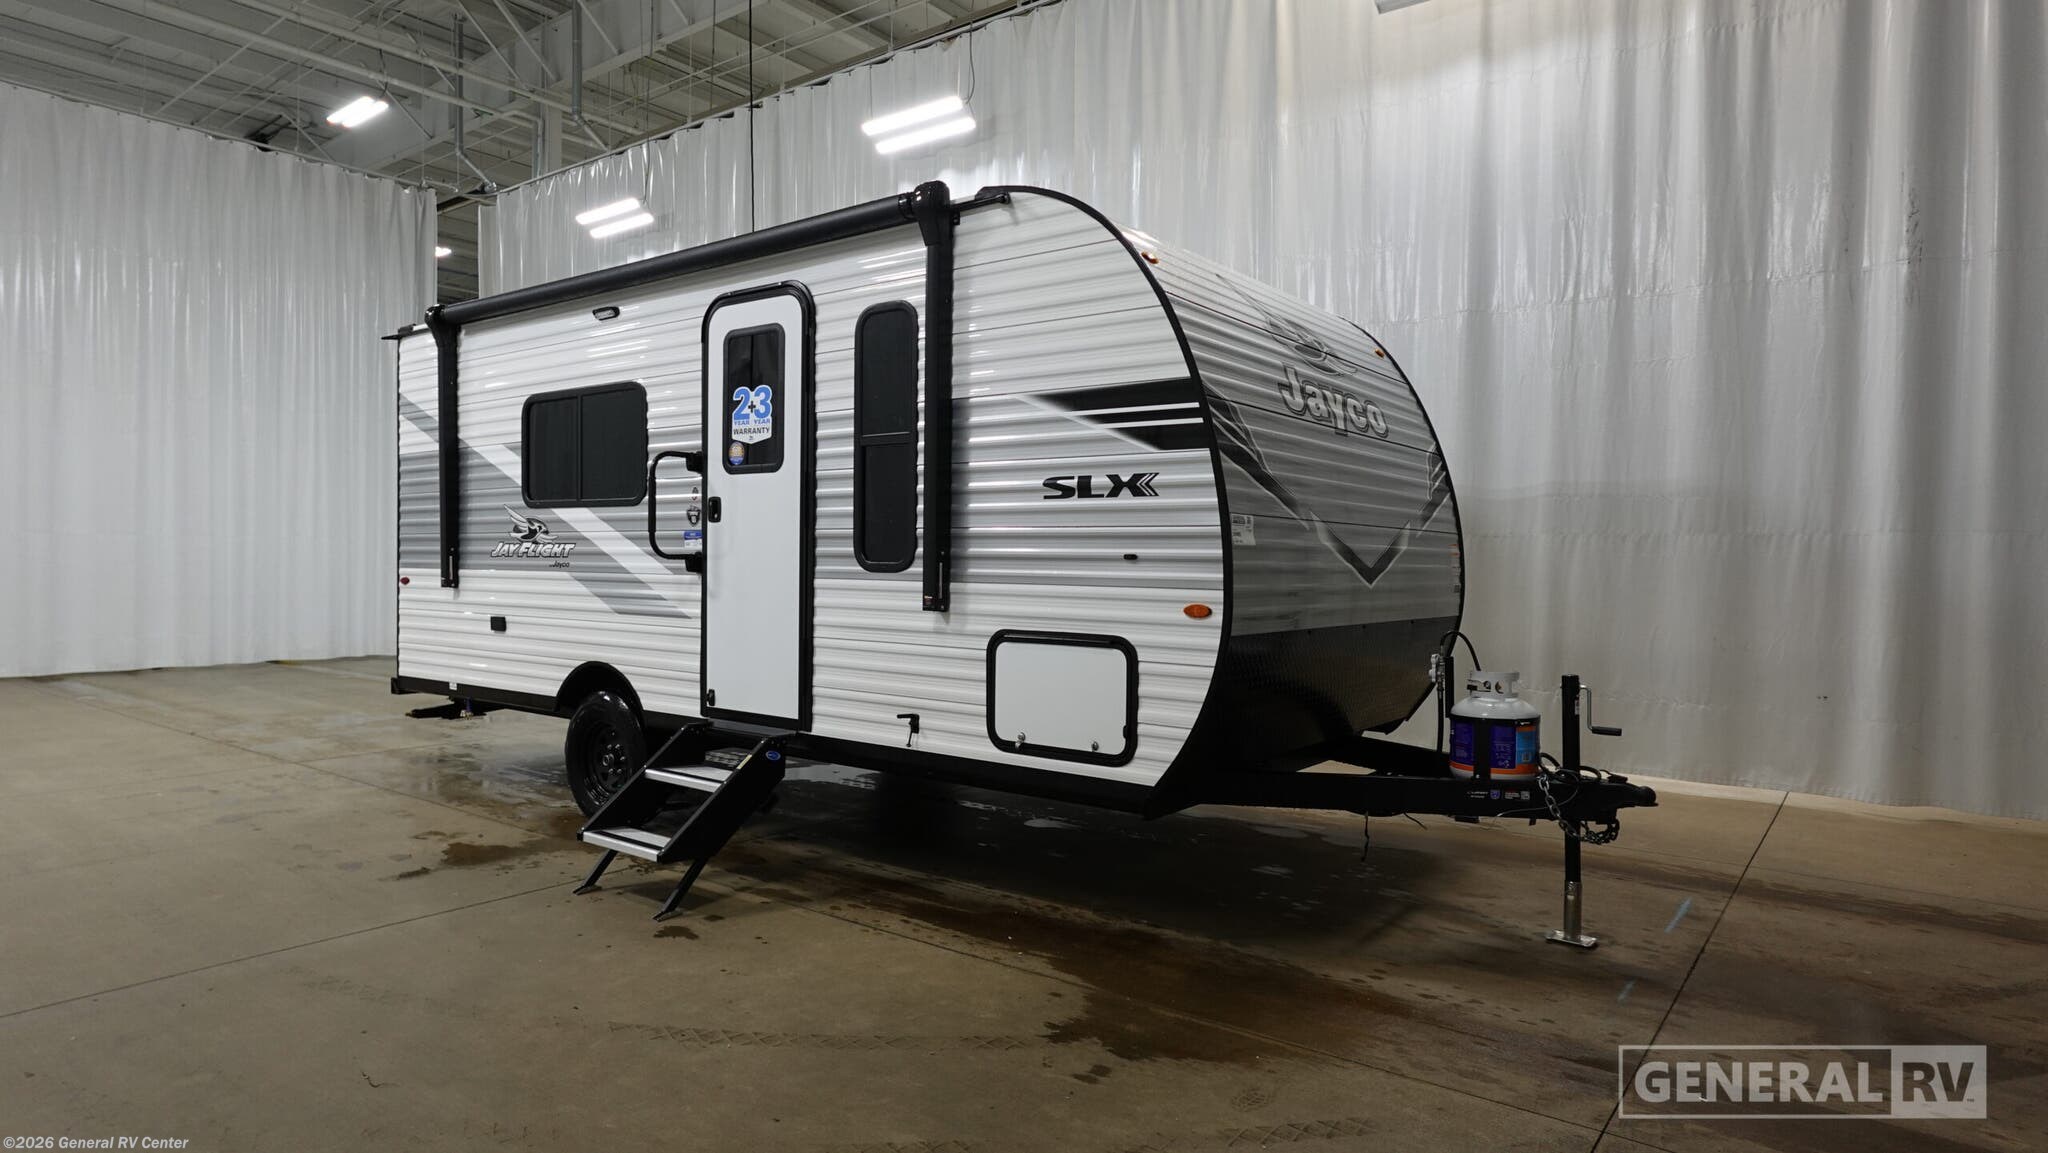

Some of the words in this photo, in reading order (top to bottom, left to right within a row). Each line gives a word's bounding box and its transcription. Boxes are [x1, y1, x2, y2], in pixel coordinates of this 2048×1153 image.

[1278, 366, 1389, 439] Jayco
[733, 427, 770, 436] WARRANTY
[1042, 472, 1160, 499] SLX
[491, 542, 521, 558] JAY
[517, 541, 576, 558] FLIGHT
